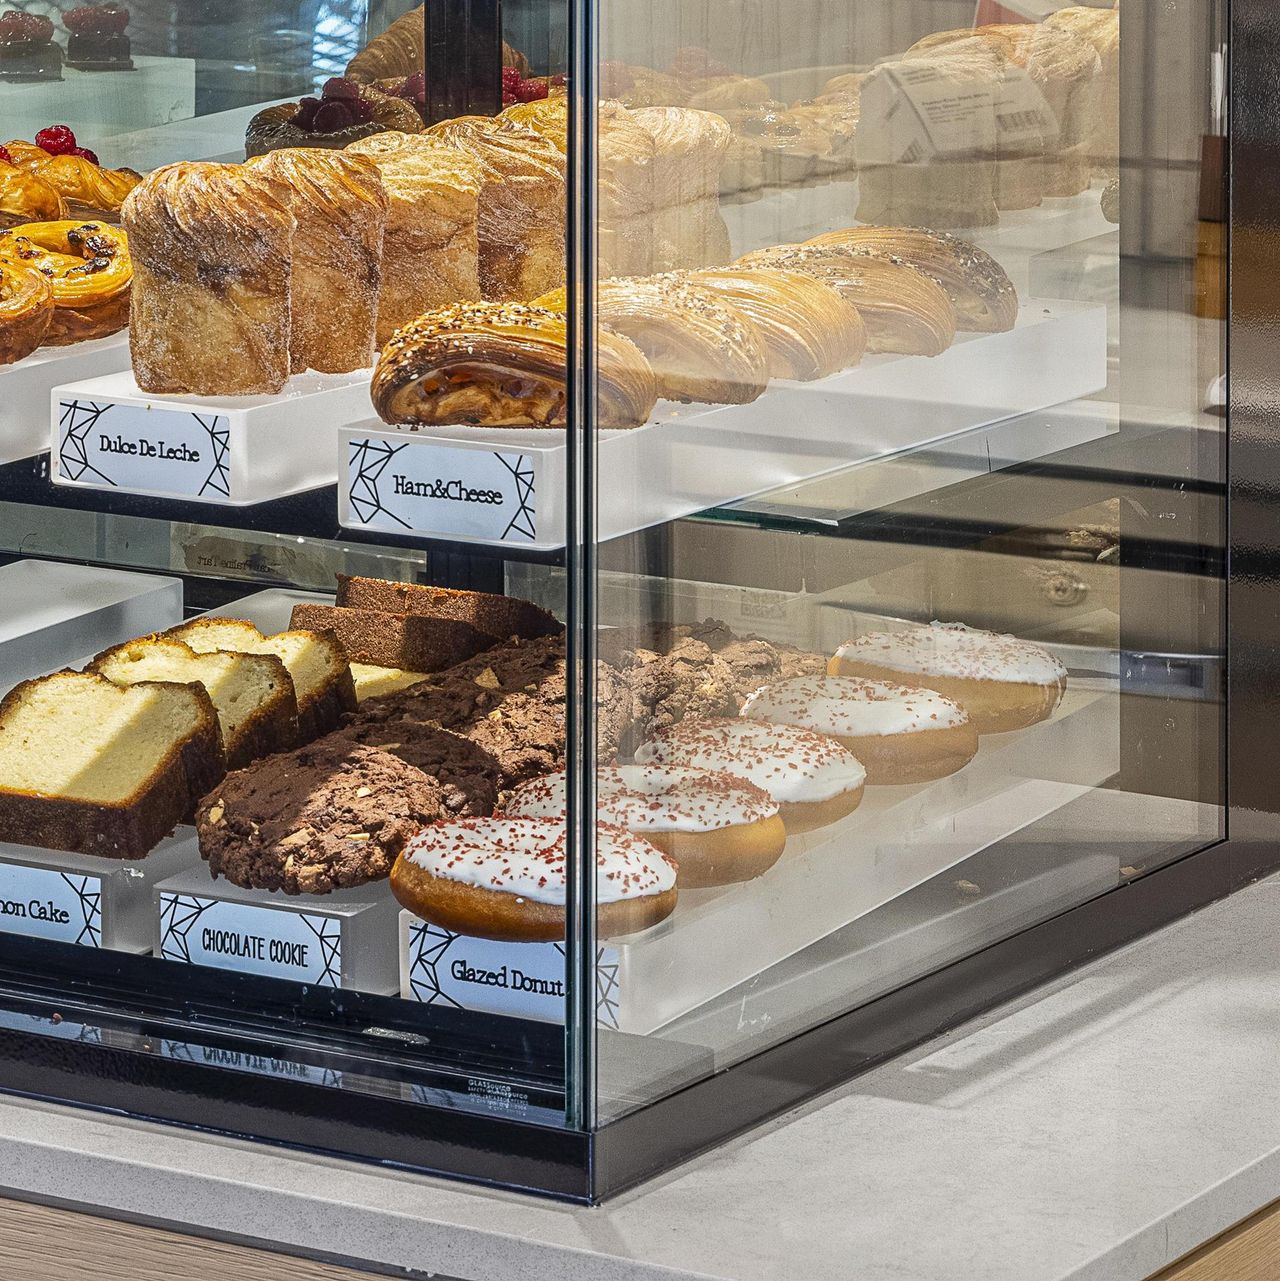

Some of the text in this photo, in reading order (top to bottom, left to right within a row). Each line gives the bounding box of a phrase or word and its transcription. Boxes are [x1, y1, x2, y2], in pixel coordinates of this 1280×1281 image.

[99, 434, 201, 463] Dulce De Leche
[392, 474, 503, 505] Ham&Cheese
[27, 900, 70, 925] Cake
[201, 927, 309, 968] CHOCOLATE COOKIE
[450, 959, 565, 998] Glazed Donut
